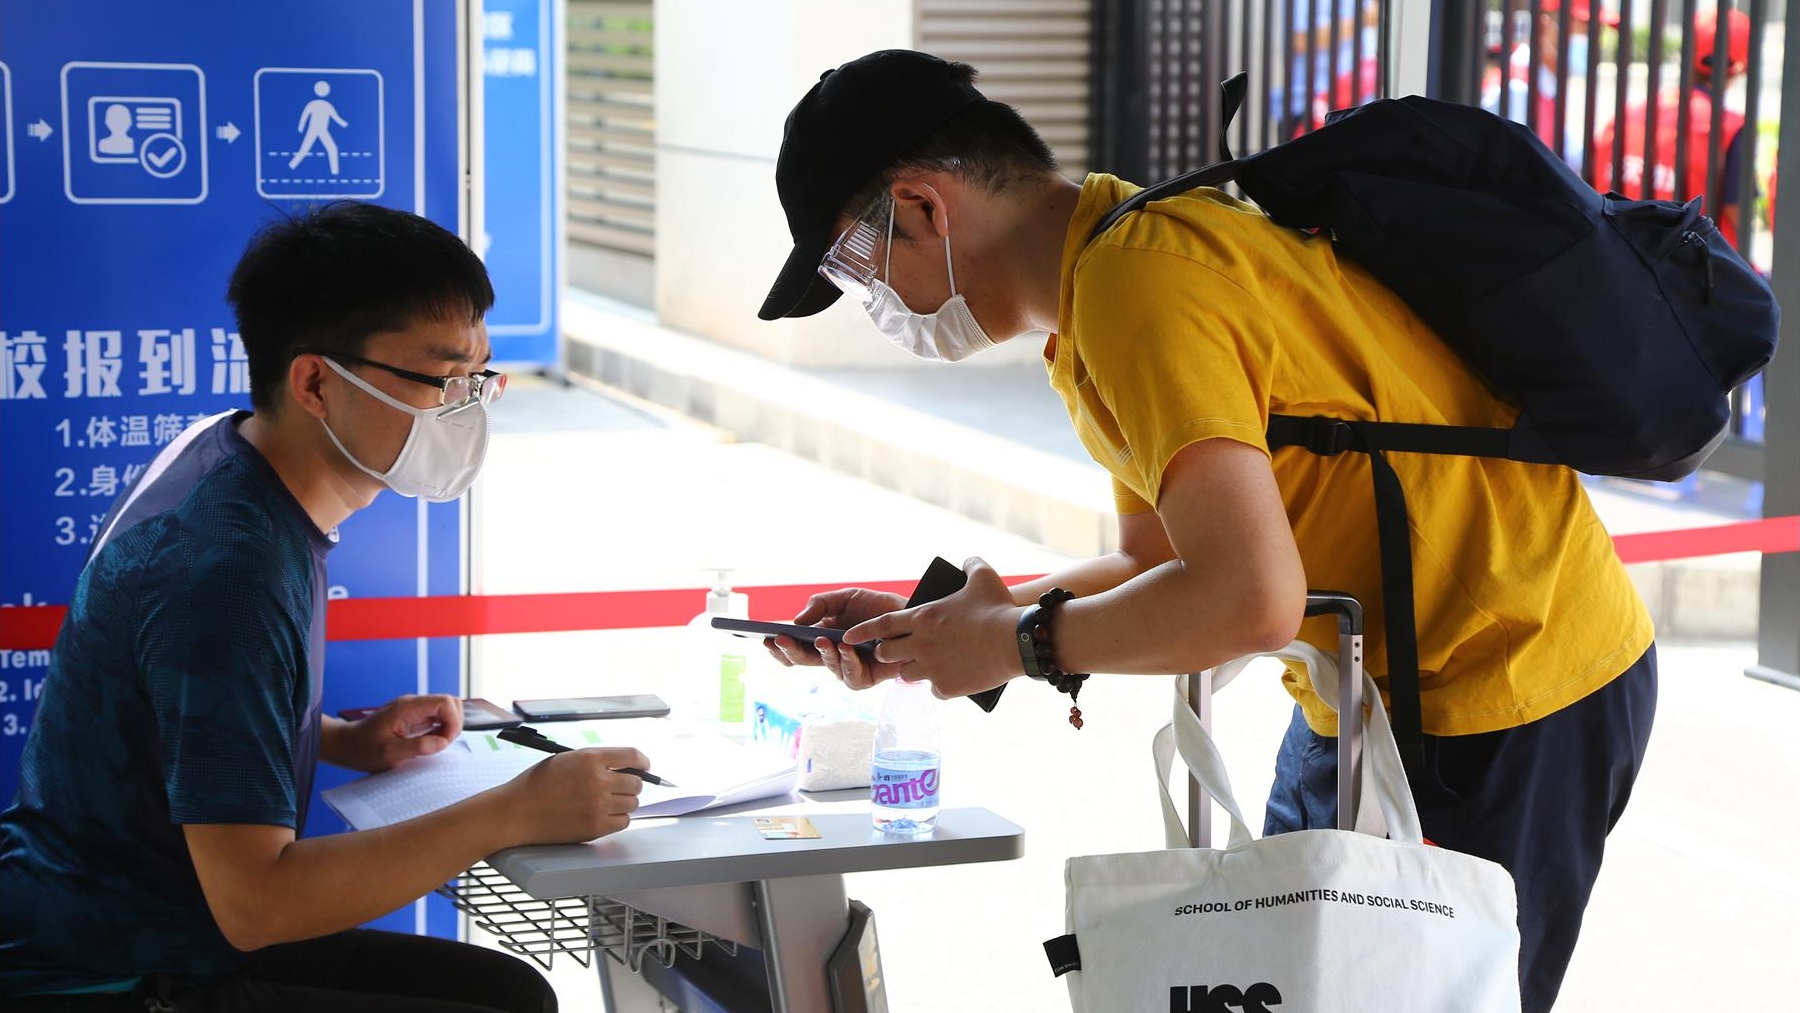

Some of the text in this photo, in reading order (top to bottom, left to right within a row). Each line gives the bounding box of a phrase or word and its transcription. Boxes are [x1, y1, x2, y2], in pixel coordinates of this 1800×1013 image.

[55, 513, 107, 546] 3.
[3, 713, 27, 736] 3.
[1174, 889, 1455, 918] SCHOOL OF HUMANITIES AND SOCIAL SCIENCE
